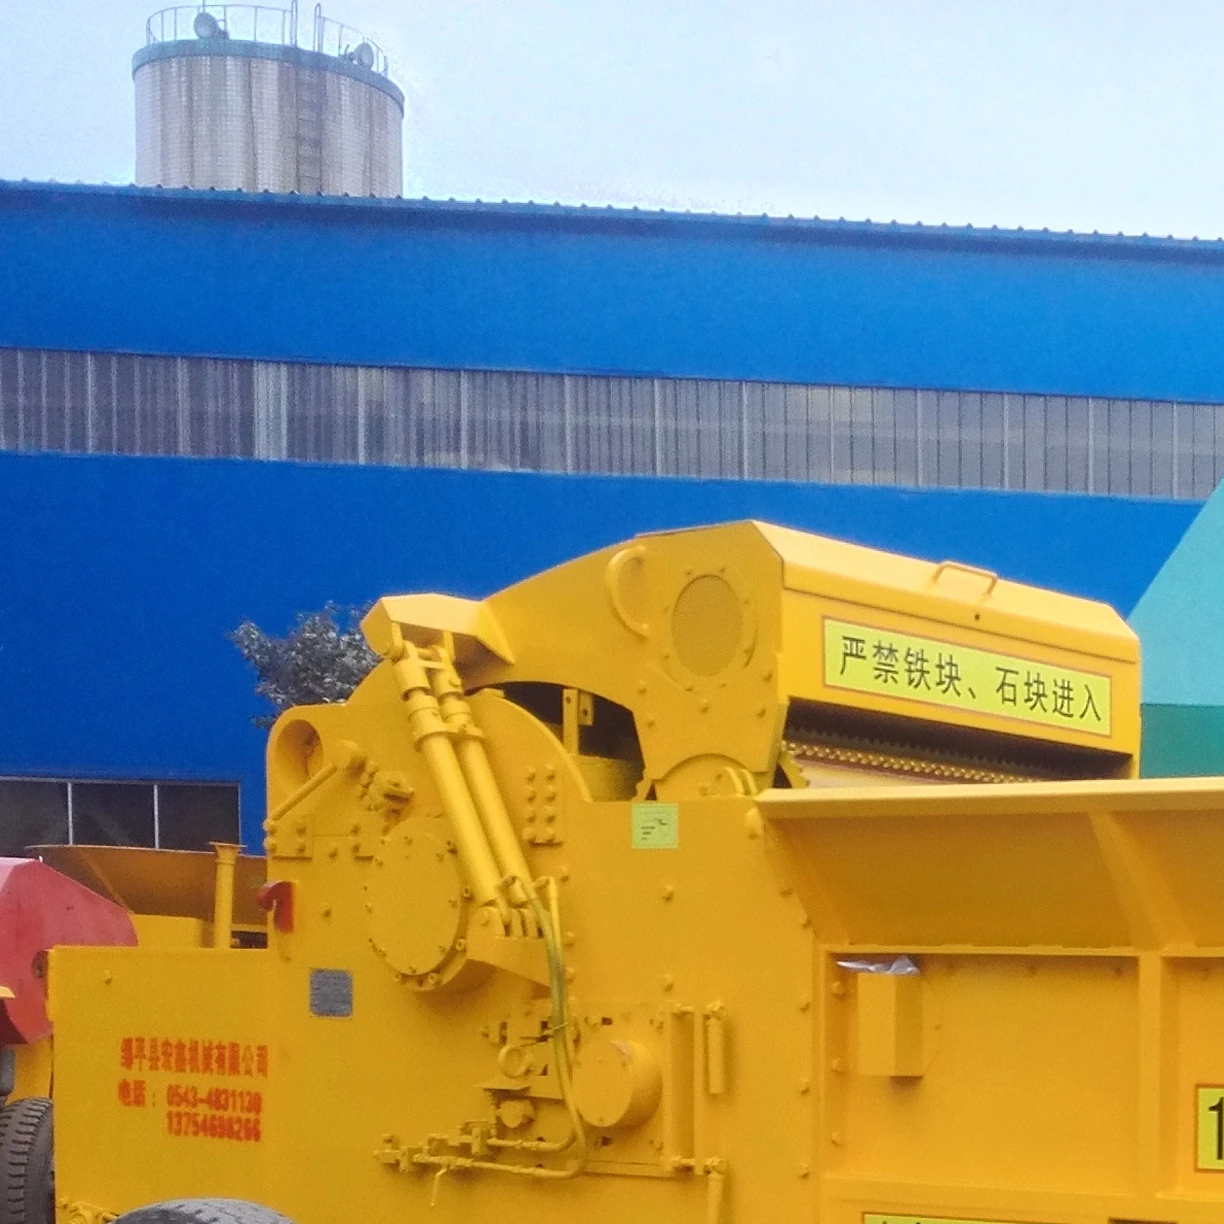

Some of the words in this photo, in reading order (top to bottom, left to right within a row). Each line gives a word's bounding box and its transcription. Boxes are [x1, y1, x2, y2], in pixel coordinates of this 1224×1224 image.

[840, 634, 1101, 722] 严禁铁块、石块进入
